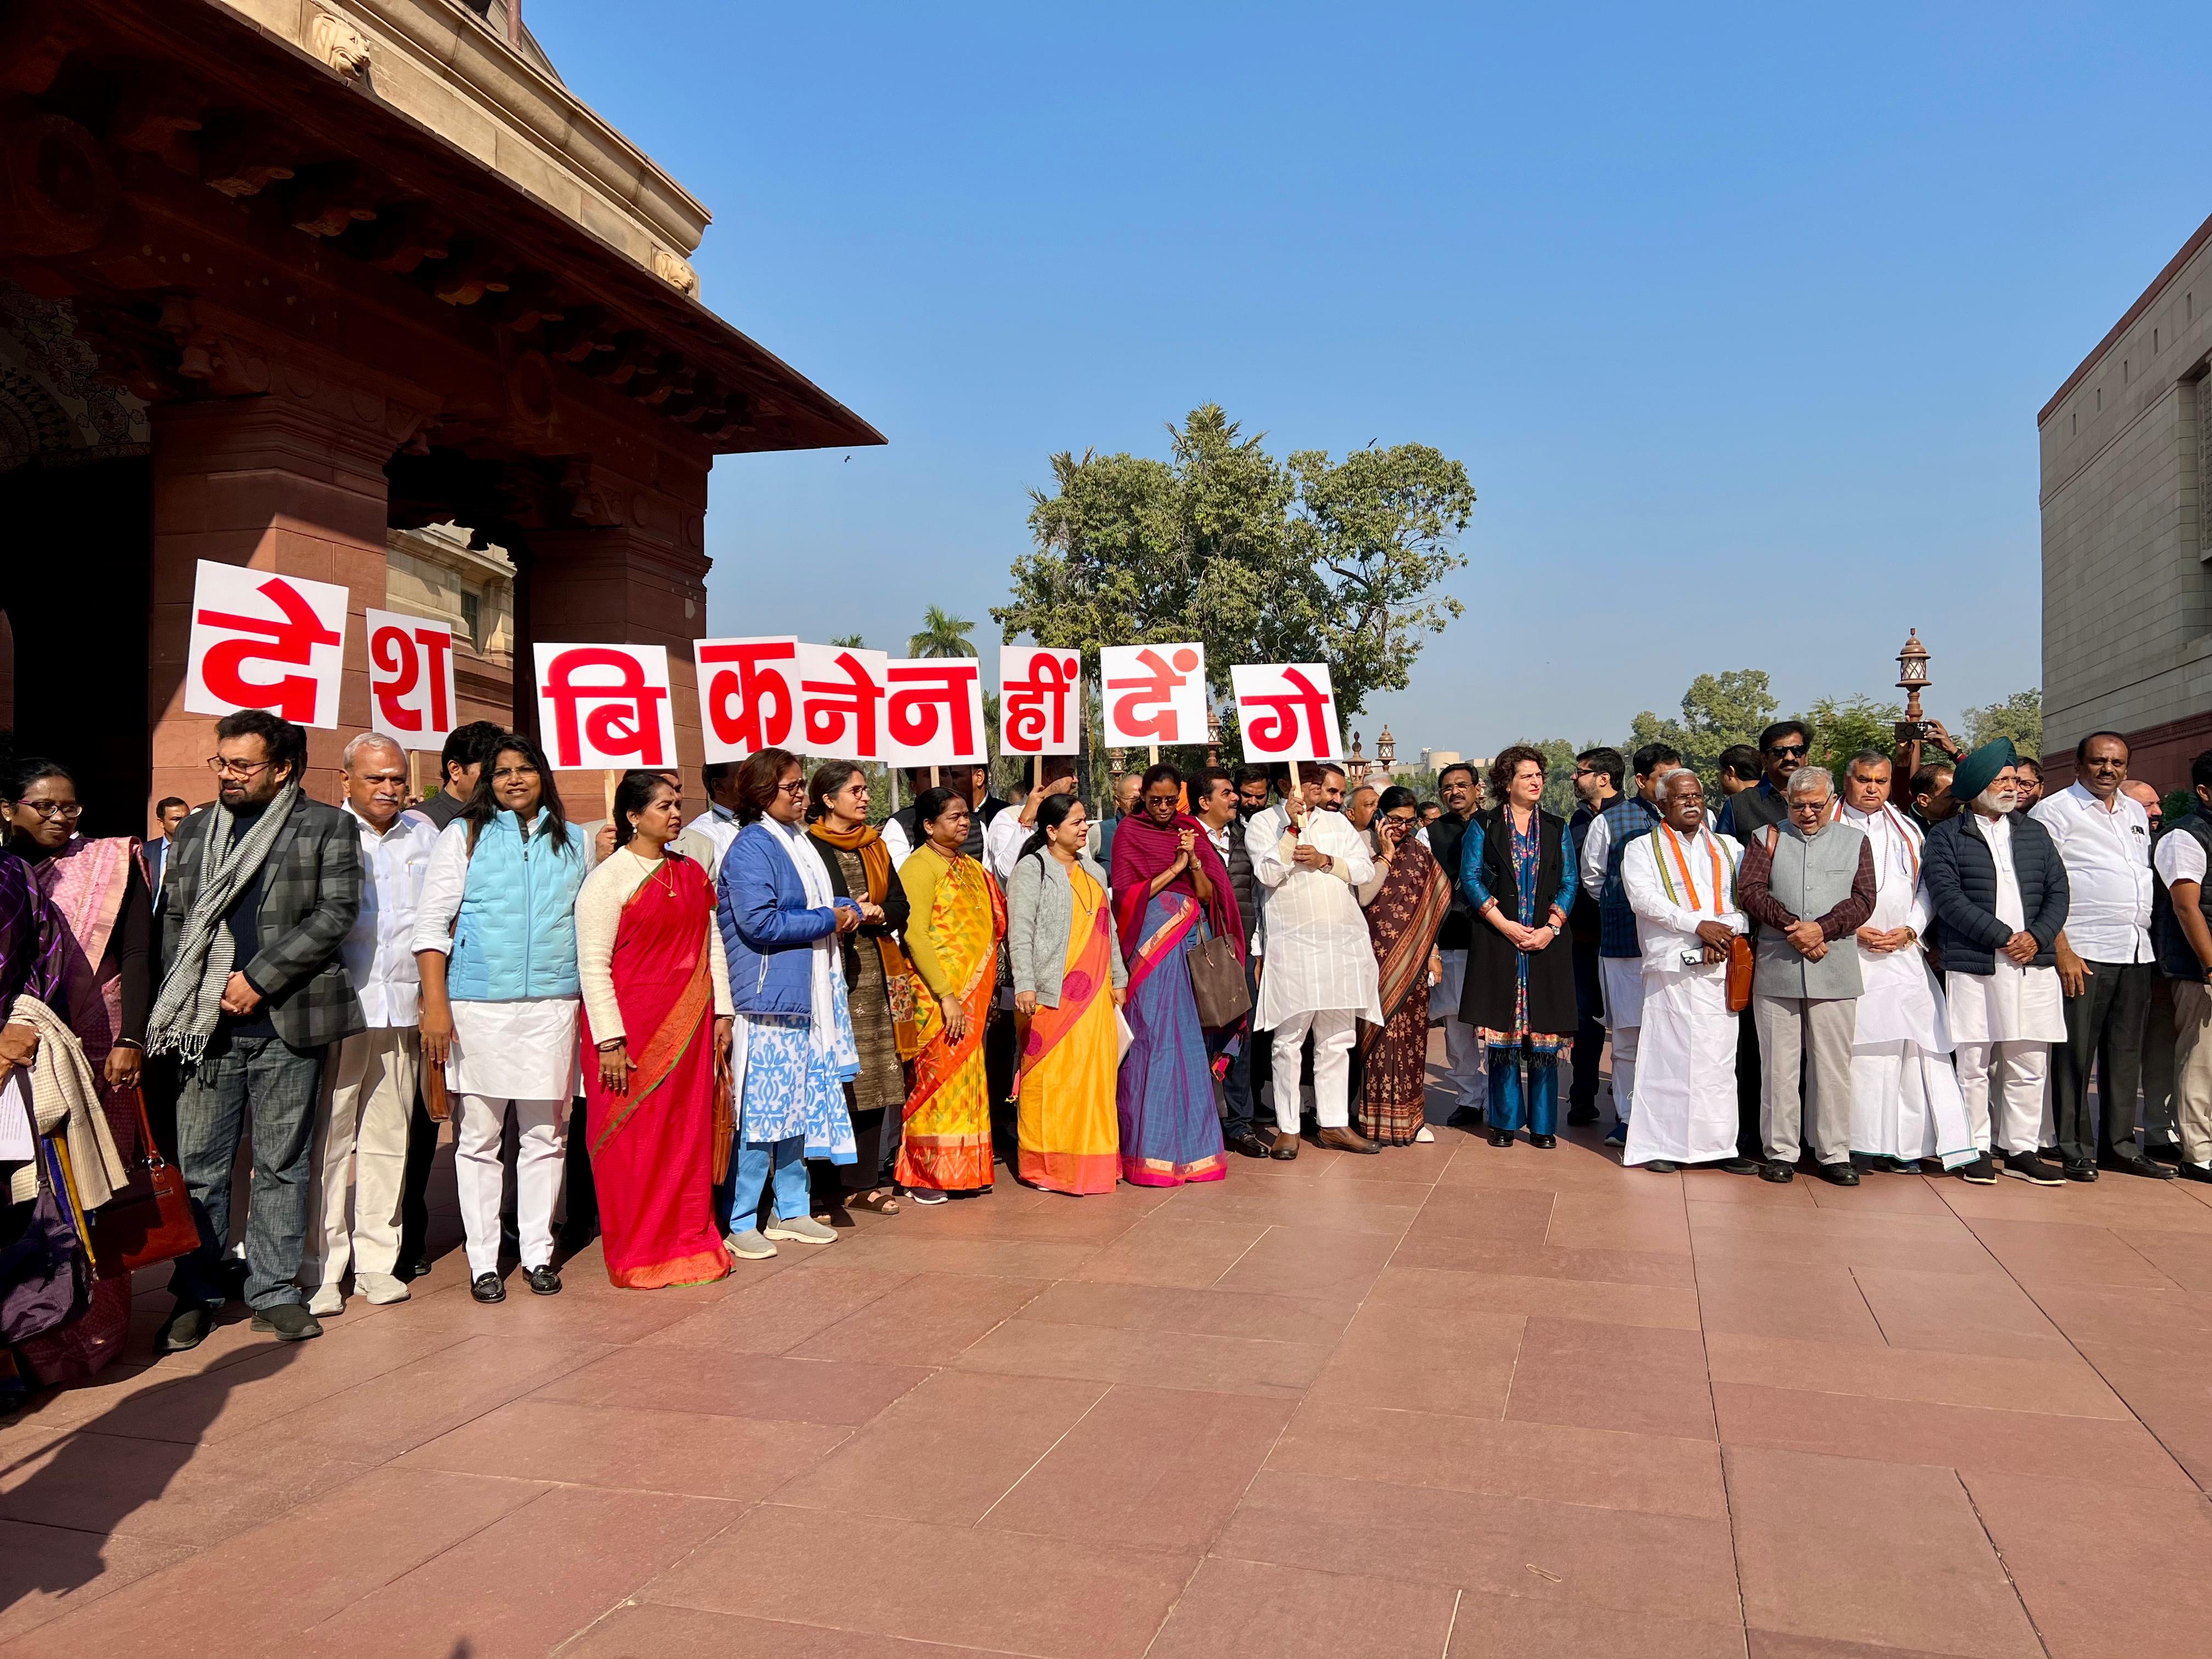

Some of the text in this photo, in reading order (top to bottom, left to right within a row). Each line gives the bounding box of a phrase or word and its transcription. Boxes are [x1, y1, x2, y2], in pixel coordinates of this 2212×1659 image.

[198, 578, 340, 724] दे
[371, 627, 450, 731] श
[700, 642, 794, 753] क
[1107, 648, 1199, 741] दें
[542, 648, 667, 766] बि
[888, 667, 977, 755] न
[1003, 653, 1077, 752] हीं
[1240, 667, 1330, 758] गे
